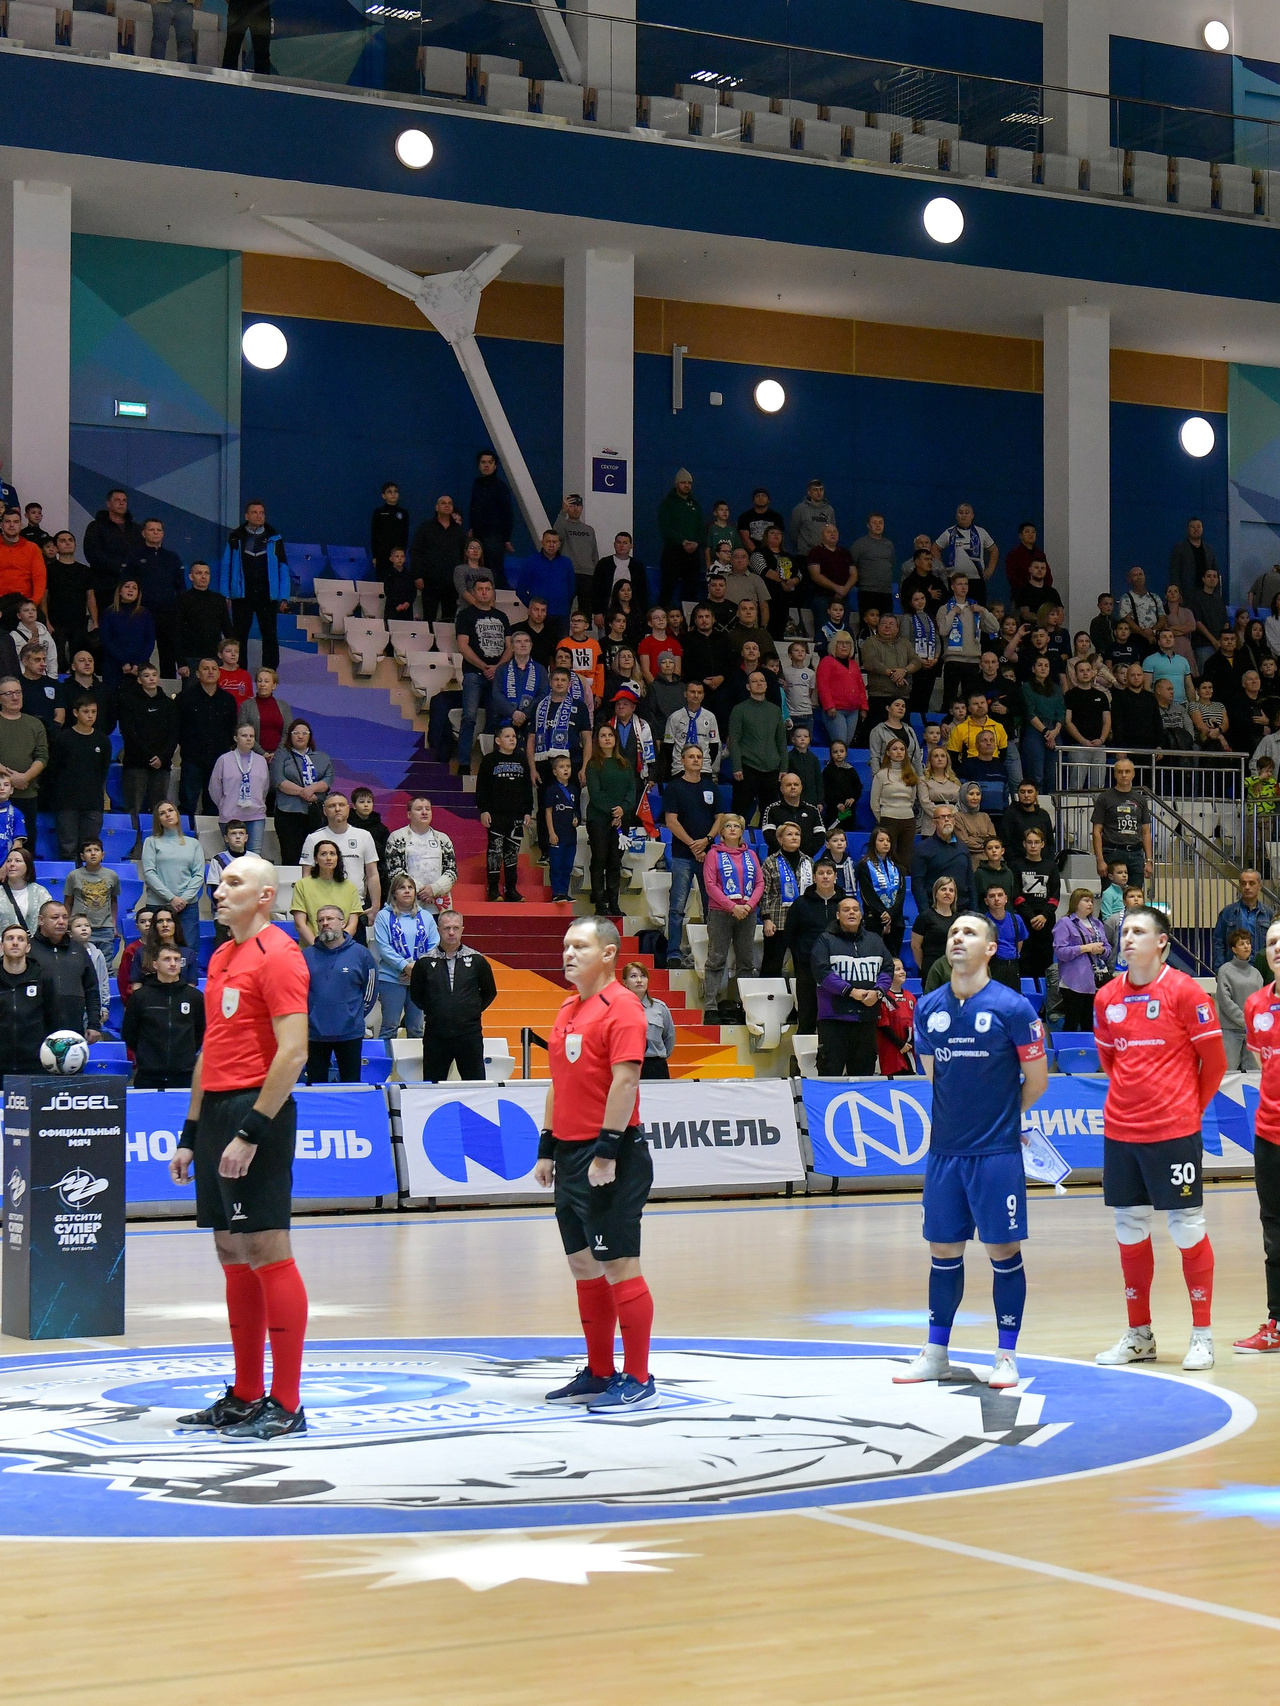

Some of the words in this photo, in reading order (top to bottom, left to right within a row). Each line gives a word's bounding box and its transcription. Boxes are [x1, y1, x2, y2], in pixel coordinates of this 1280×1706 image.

[576, 656, 590, 667] VR
[41, 1092, 118, 1111] JÖGEL
[38, 1126, 121, 1138] ОФИЦИАЛЬНЫЙ
[68, 1138, 91, 1147] МЯЧ
[1170, 1163, 1196, 1185] 30
[1006, 1194, 1018, 1216] 9
[54, 1213, 102, 1222] БЕТСИТИ
[54, 1223, 102, 1234] СУПЕР
[58, 1234, 97, 1245] ЛИГА
